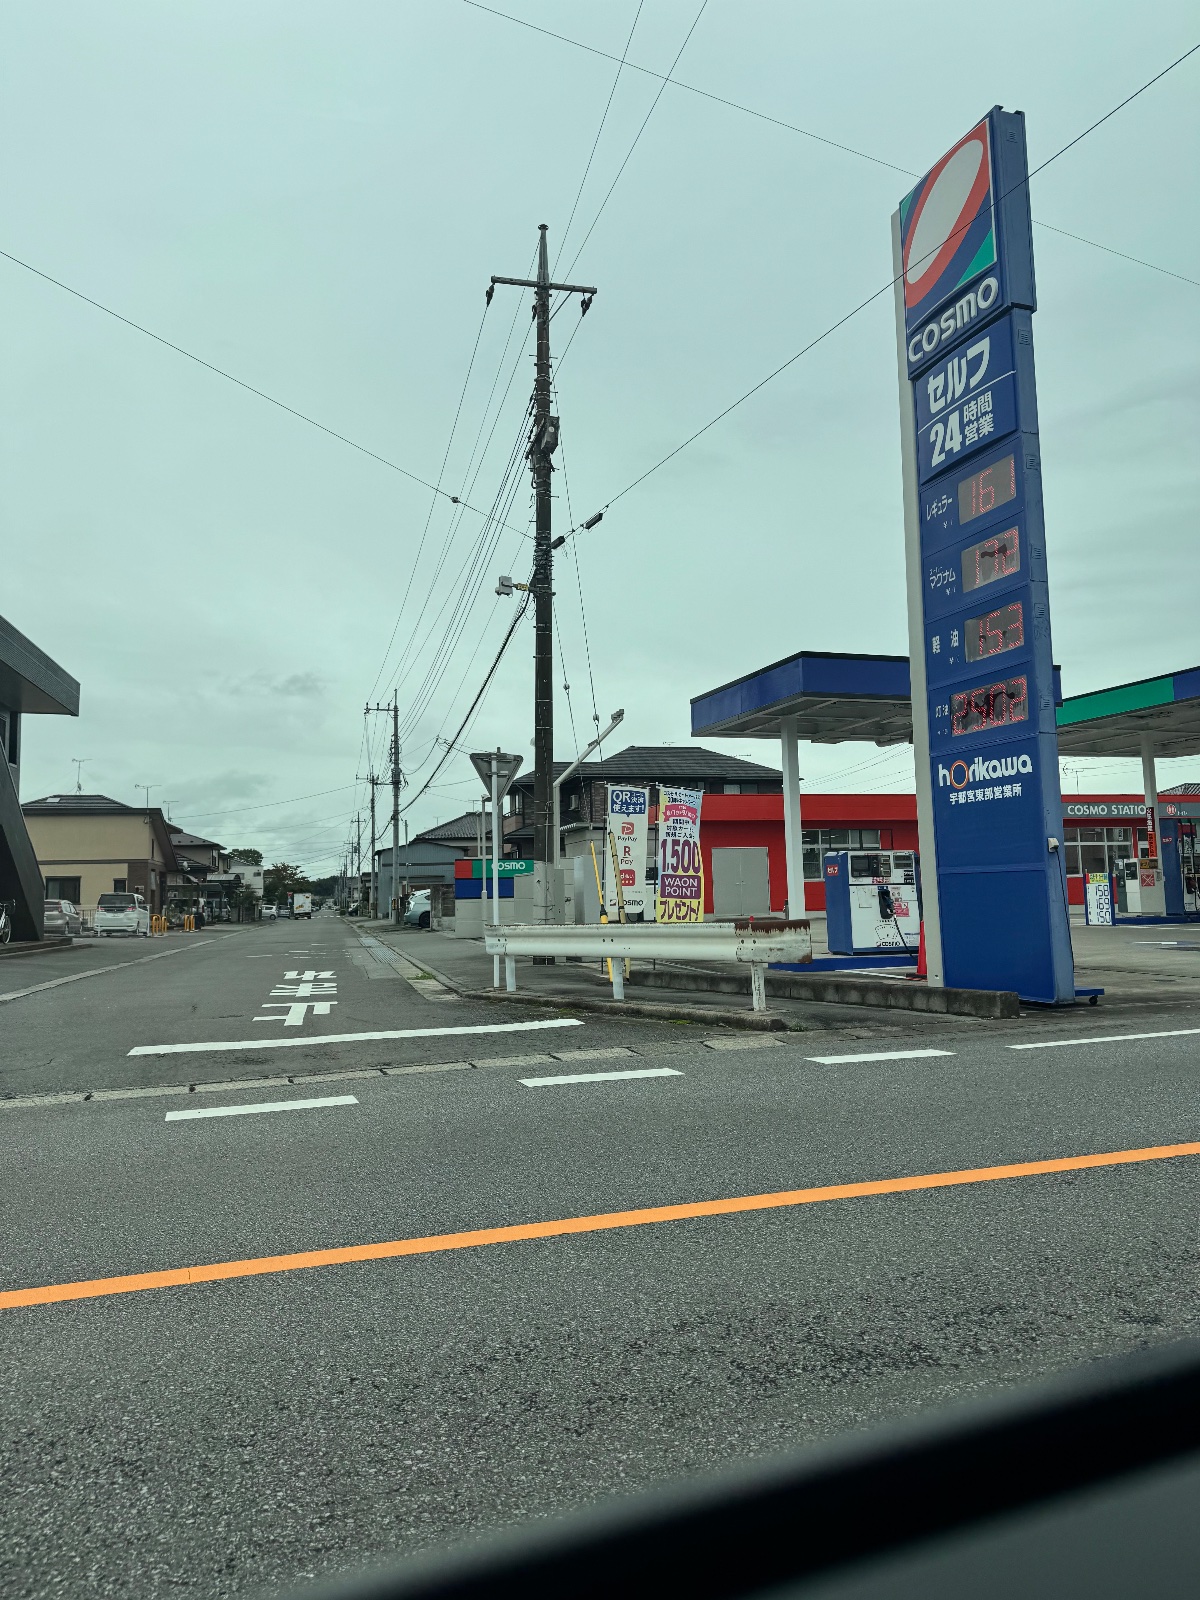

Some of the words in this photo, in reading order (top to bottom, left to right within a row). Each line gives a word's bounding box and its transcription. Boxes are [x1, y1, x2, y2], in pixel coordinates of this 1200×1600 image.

[928, 336, 990, 414] セルフ
[964, 391, 992, 424] 時間
[930, 410, 962, 467] 24
[965, 413, 995, 446] 営業
[926, 494, 953, 521] レギュラー
[975, 529, 1018, 585] 172
[930, 568, 956, 590] マグナム
[979, 603, 1022, 655] 153
[953, 677, 1027, 735] 2502
[612, 791, 631, 804] QR
[949, 782, 1022, 805] 宇都宮東部営業所
[1067, 804, 1108, 816] COSMO
[1111, 804, 1147, 816] STATIO
[663, 877, 698, 887] WAON
[665, 887, 698, 897] POINT
[1095, 884, 1110, 897] 158
